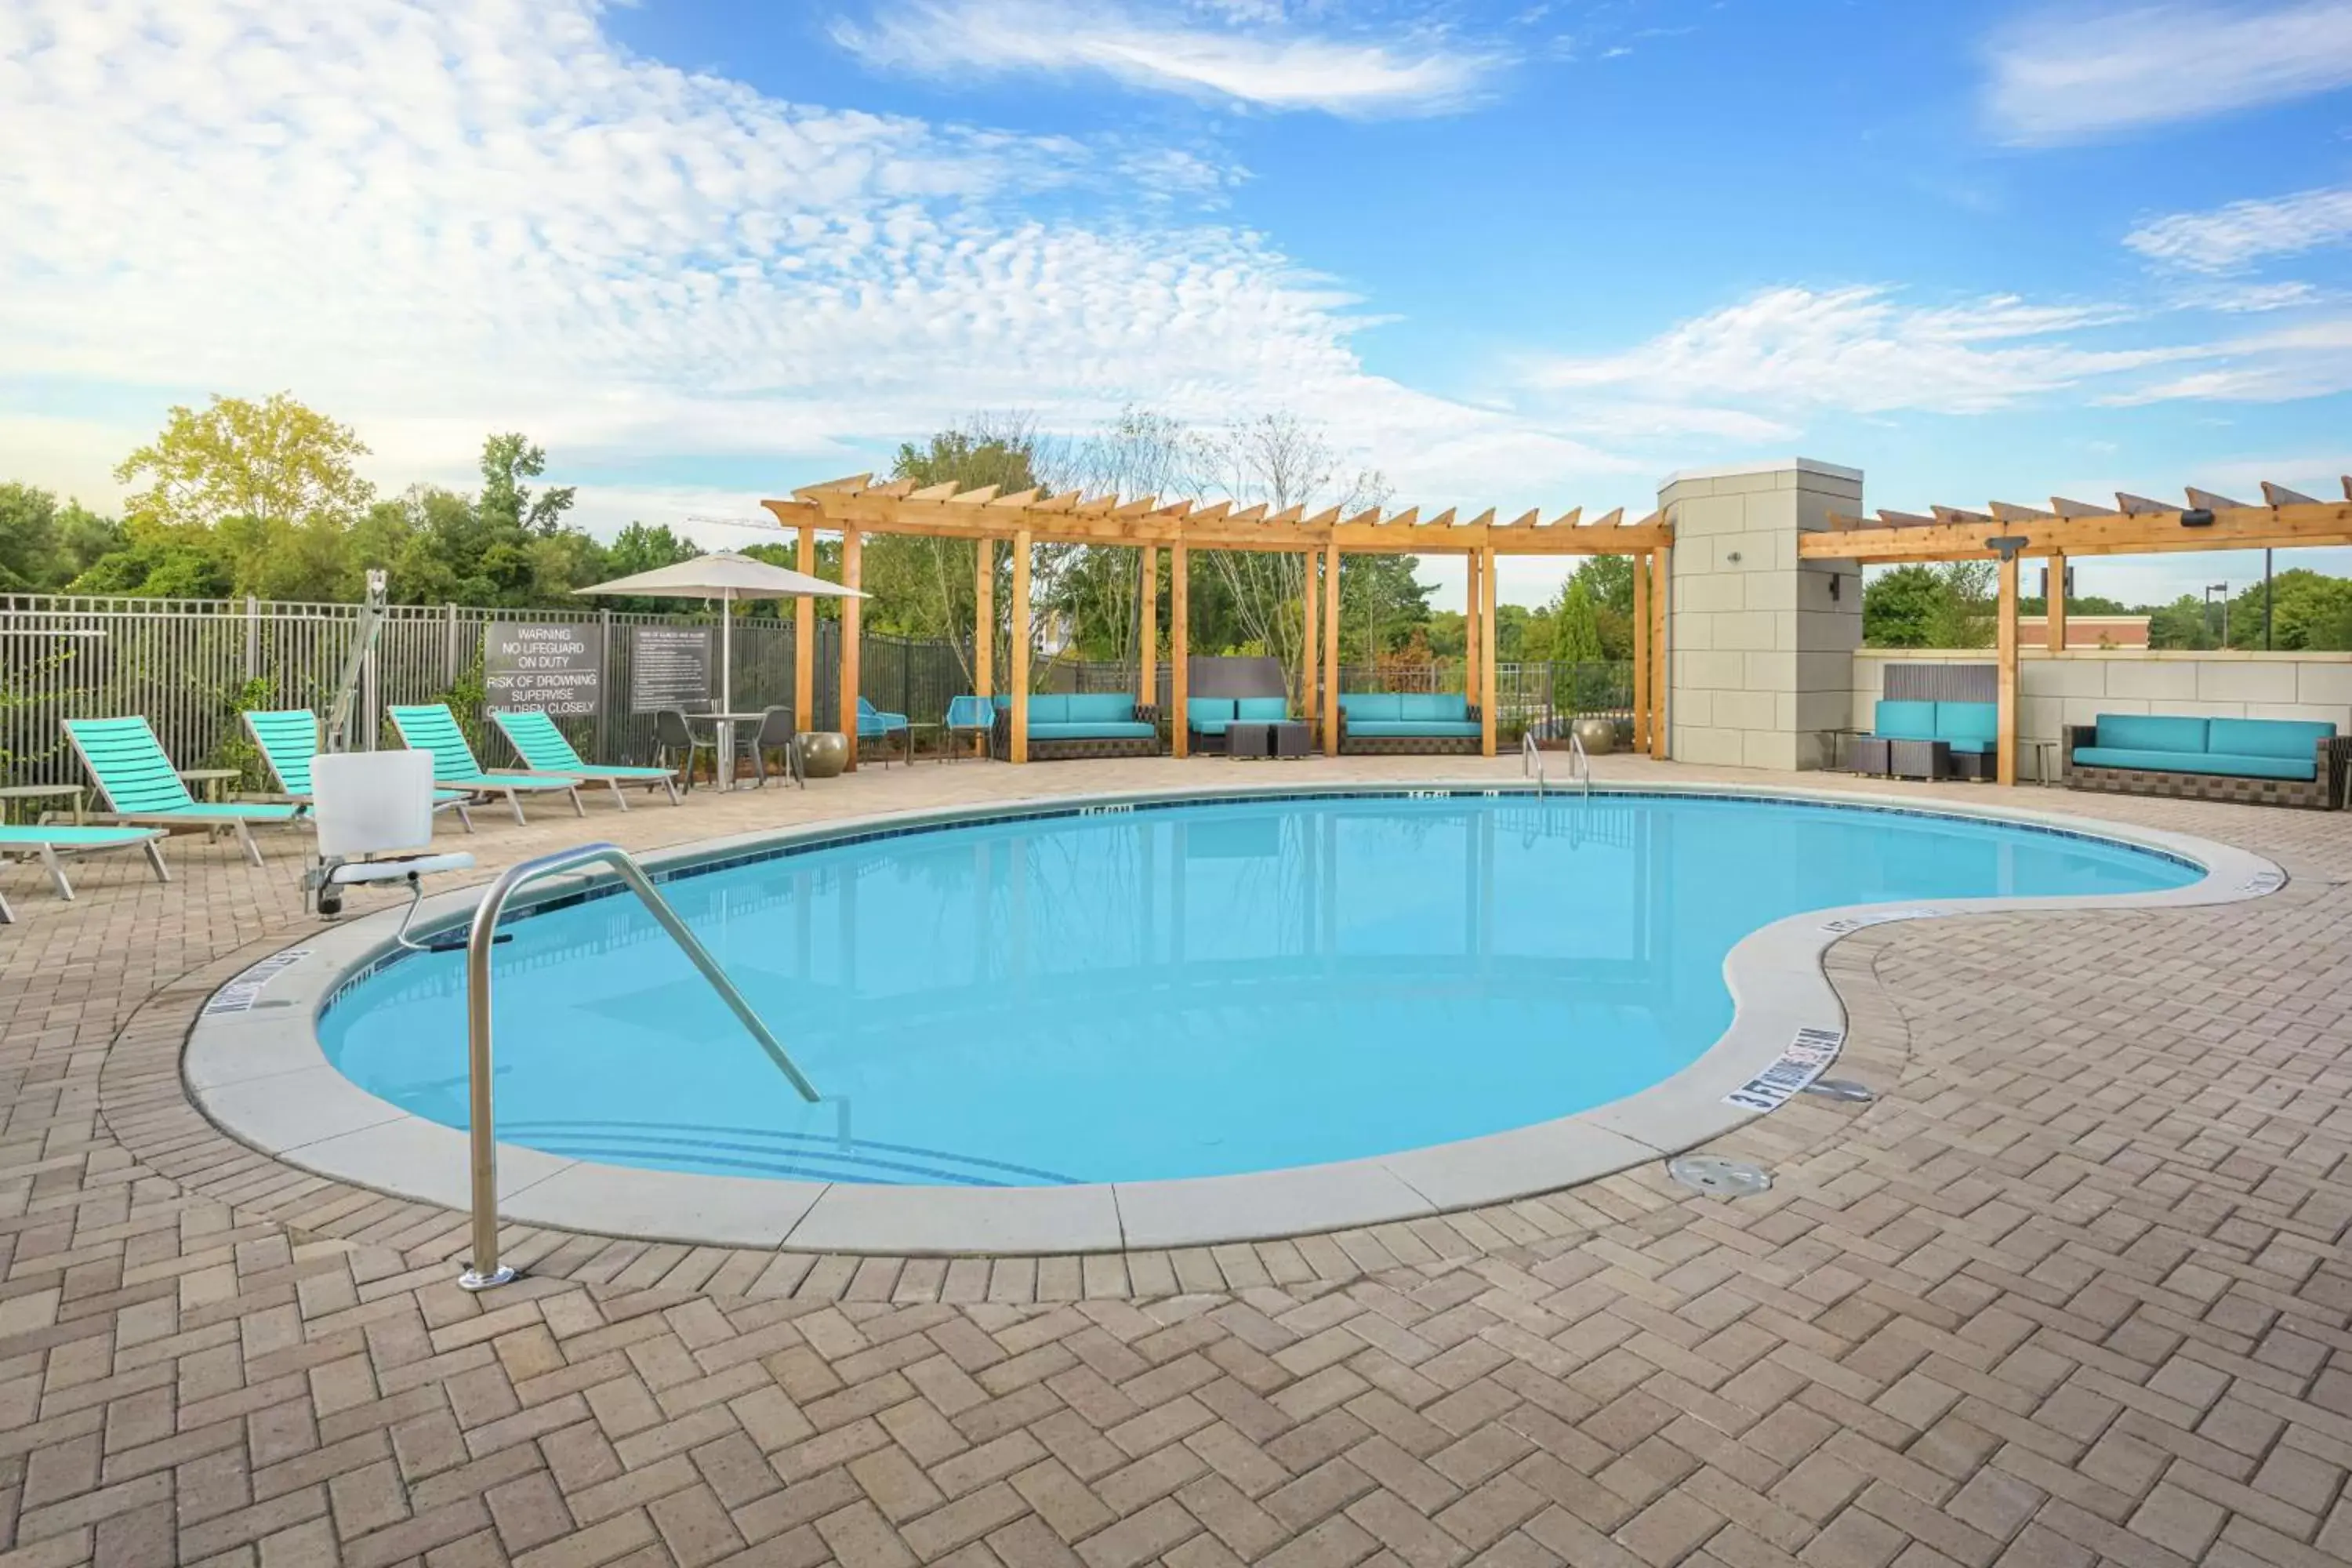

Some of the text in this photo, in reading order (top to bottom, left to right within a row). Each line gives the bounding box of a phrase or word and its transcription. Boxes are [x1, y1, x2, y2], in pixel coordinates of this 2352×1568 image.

[518, 628, 571, 641] WARNING
[503, 641, 584, 654] NO LIFEGUARD
[518, 655, 570, 668] ON DUTY
[487, 673, 597, 688] RISK OF DROWNING
[512, 688, 574, 702] SUPERVISE
[548, 702, 594, 714] CLOSELY
